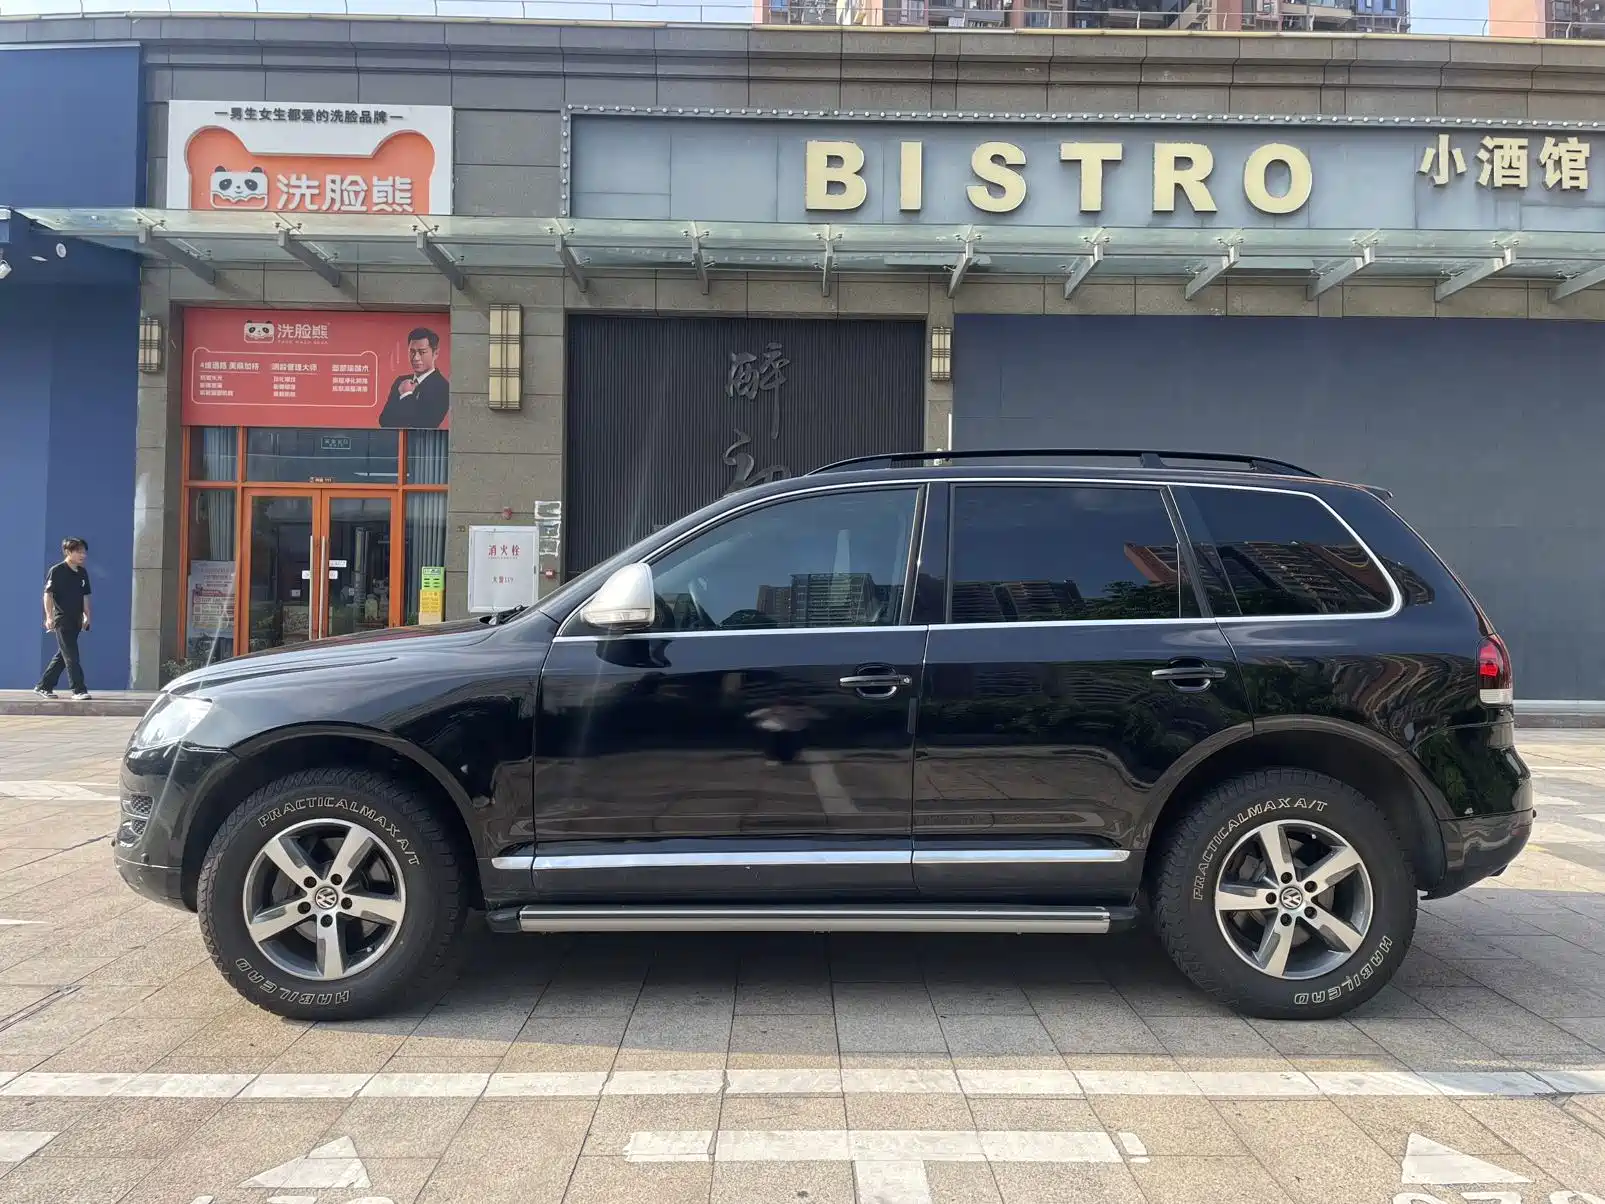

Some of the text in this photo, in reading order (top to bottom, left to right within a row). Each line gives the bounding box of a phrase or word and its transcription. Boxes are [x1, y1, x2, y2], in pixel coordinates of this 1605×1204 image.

[230, 107, 387, 124] 男生女生都爱的洗脸品牌
[1417, 134, 1590, 190] 小酒馆
[805, 140, 1313, 214] BISTRO
[276, 173, 414, 212] 洗脸熊
[277, 323, 328, 339] 洗脸熊
[488, 544, 520, 556] 消火栓
[1294, 798, 1328, 812] A/T
[257, 796, 420, 866] PRACTICALMAX A/T
